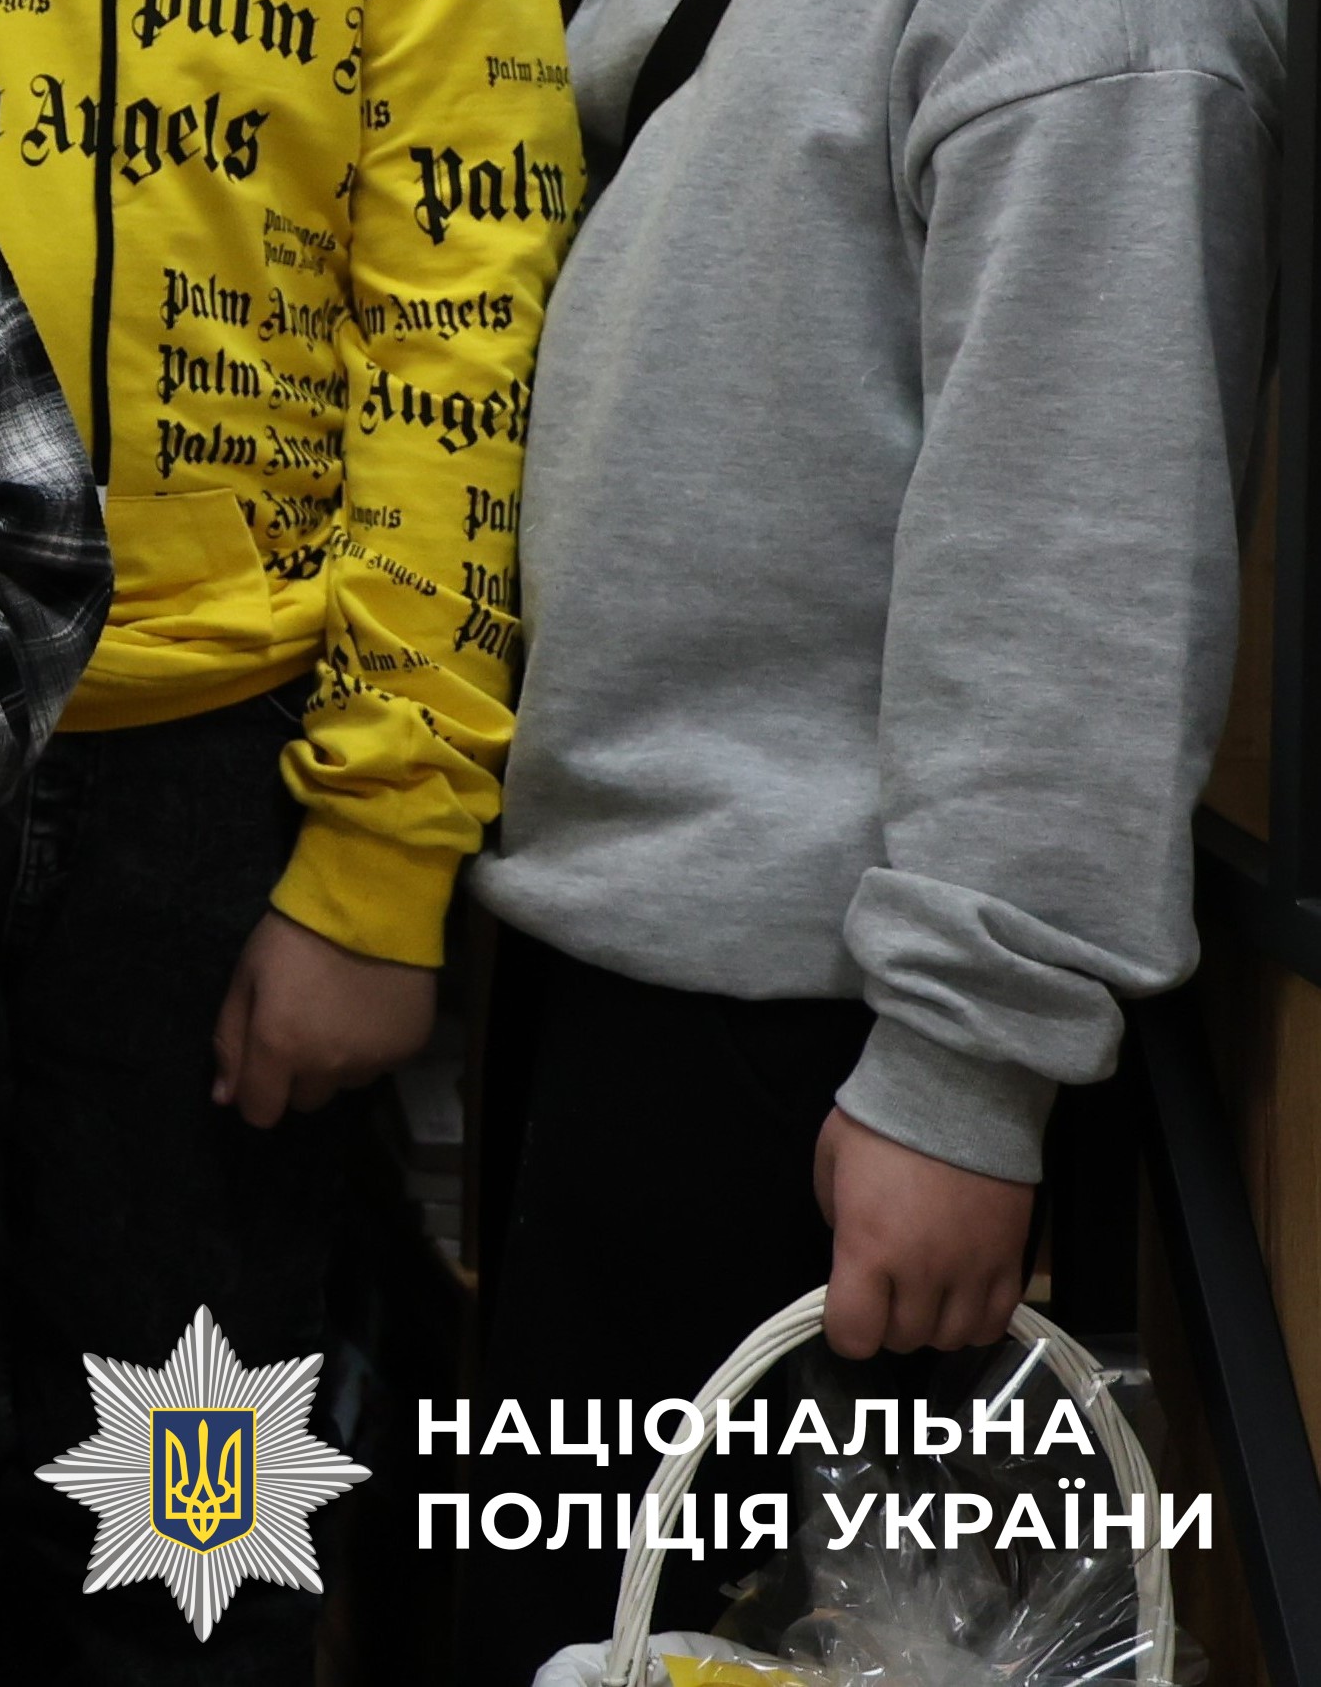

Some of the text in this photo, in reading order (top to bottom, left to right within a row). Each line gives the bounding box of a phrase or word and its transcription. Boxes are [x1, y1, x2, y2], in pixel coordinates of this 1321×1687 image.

[485, 55, 533, 88] Palm
[160, 267, 252, 330] Palm
[391, 290, 515, 343] Angels
[158, 344, 262, 405] Palm
[156, 419, 258, 480] Palm
